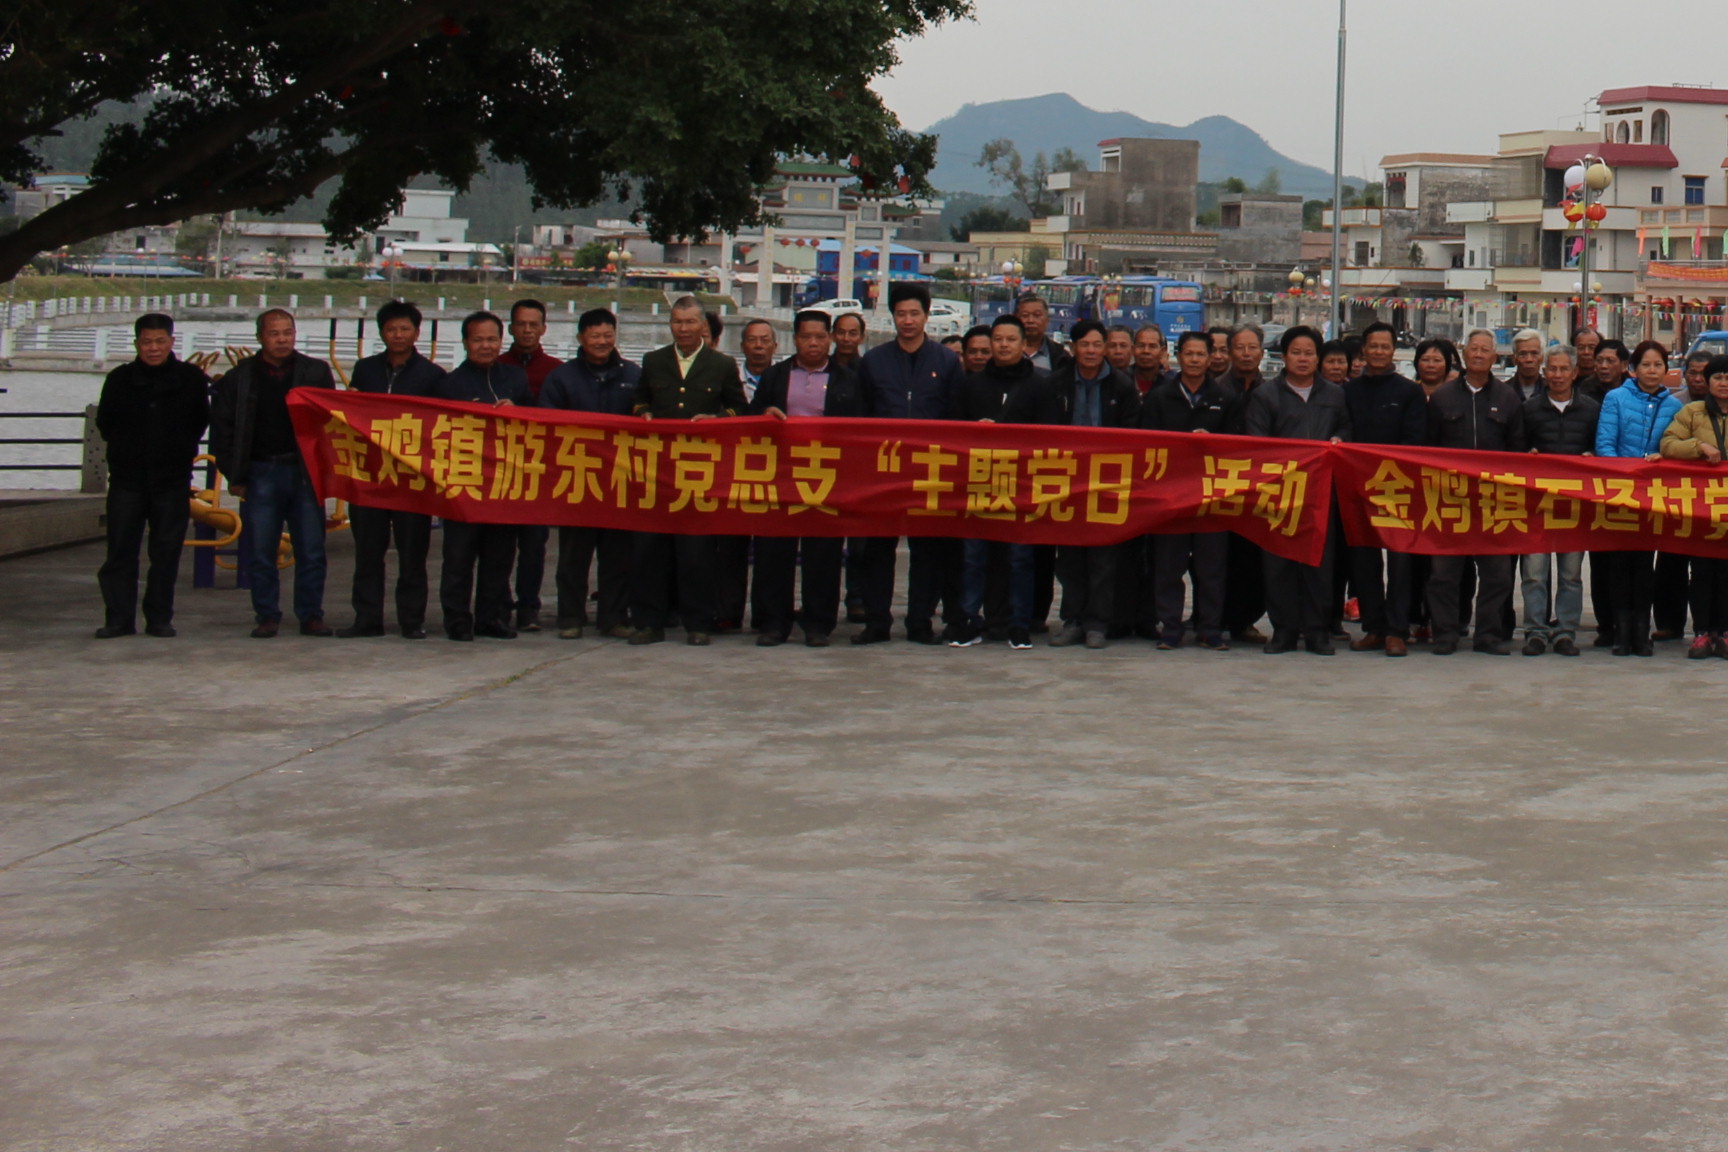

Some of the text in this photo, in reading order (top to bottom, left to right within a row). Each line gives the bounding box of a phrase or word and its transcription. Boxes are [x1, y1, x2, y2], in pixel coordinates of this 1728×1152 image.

[324, 410, 841, 520] 金鸡镇游东村党总支
[1196, 456, 1307, 536] 活动
